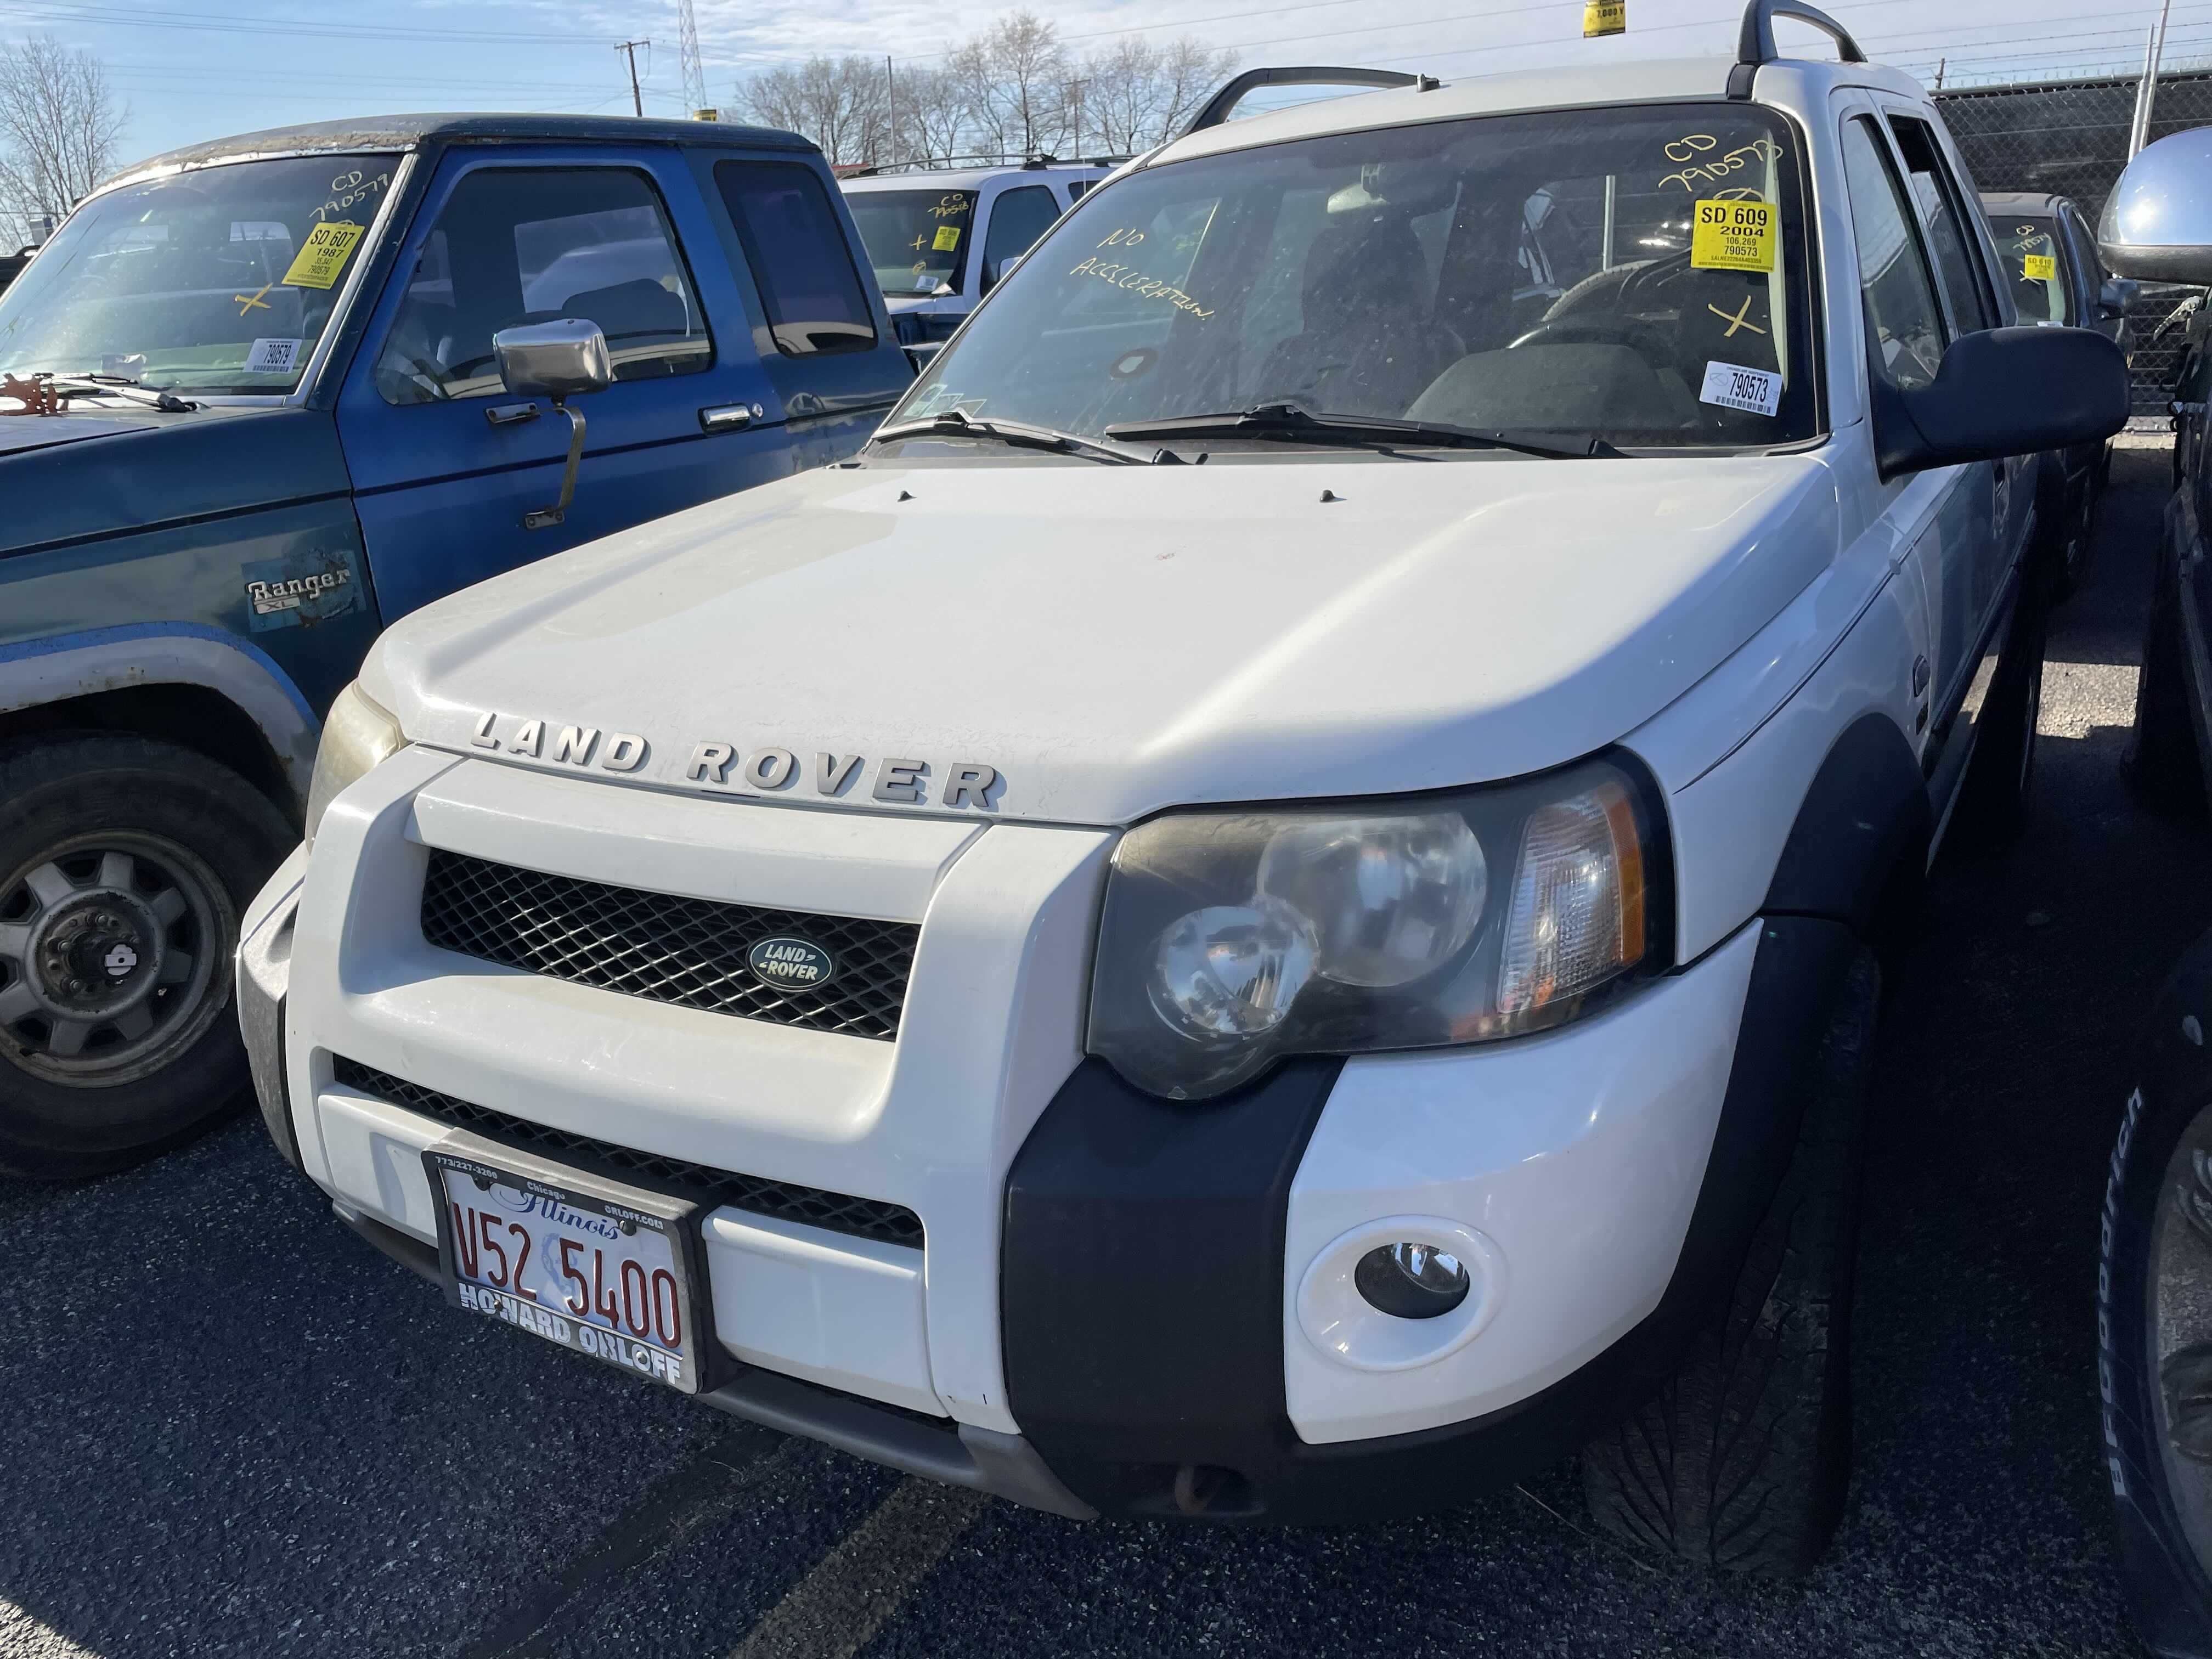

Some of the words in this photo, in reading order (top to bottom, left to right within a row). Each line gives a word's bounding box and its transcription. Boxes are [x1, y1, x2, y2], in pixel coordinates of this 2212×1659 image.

[1664, 134, 1717, 162] CD
[1658, 139, 1783, 191] 790573
[332, 171, 362, 191] CD
[309, 173, 388, 221] 790579
[1701, 207, 1726, 223] SD
[1735, 208, 1768, 226] 609
[310, 230, 330, 245] SD
[330, 231, 356, 247] 607
[1096, 228, 1144, 249] NO
[1720, 226, 1764, 237] 2004
[1726, 236, 1757, 246] 106,269
[317, 248, 345, 258] 1987
[1725, 246, 1758, 256] 790573
[307, 264, 331, 274] 790579
[263, 344, 292, 365] 790579
[1730, 373, 1769, 403] 790573
[248, 568, 351, 600] Ranger
[471, 712, 651, 772] LAND
[686, 741, 1001, 809] ROVER
[767, 960, 818, 980] ROVER
[527, 1181, 566, 1200] Chicago
[489, 1182, 620, 1240] Illinois
[452, 1201, 537, 1301] V52
[560, 1237, 681, 1348] 5400
[458, 1282, 572, 1344] HOWARD
[579, 1325, 681, 1385] ORLOFF
